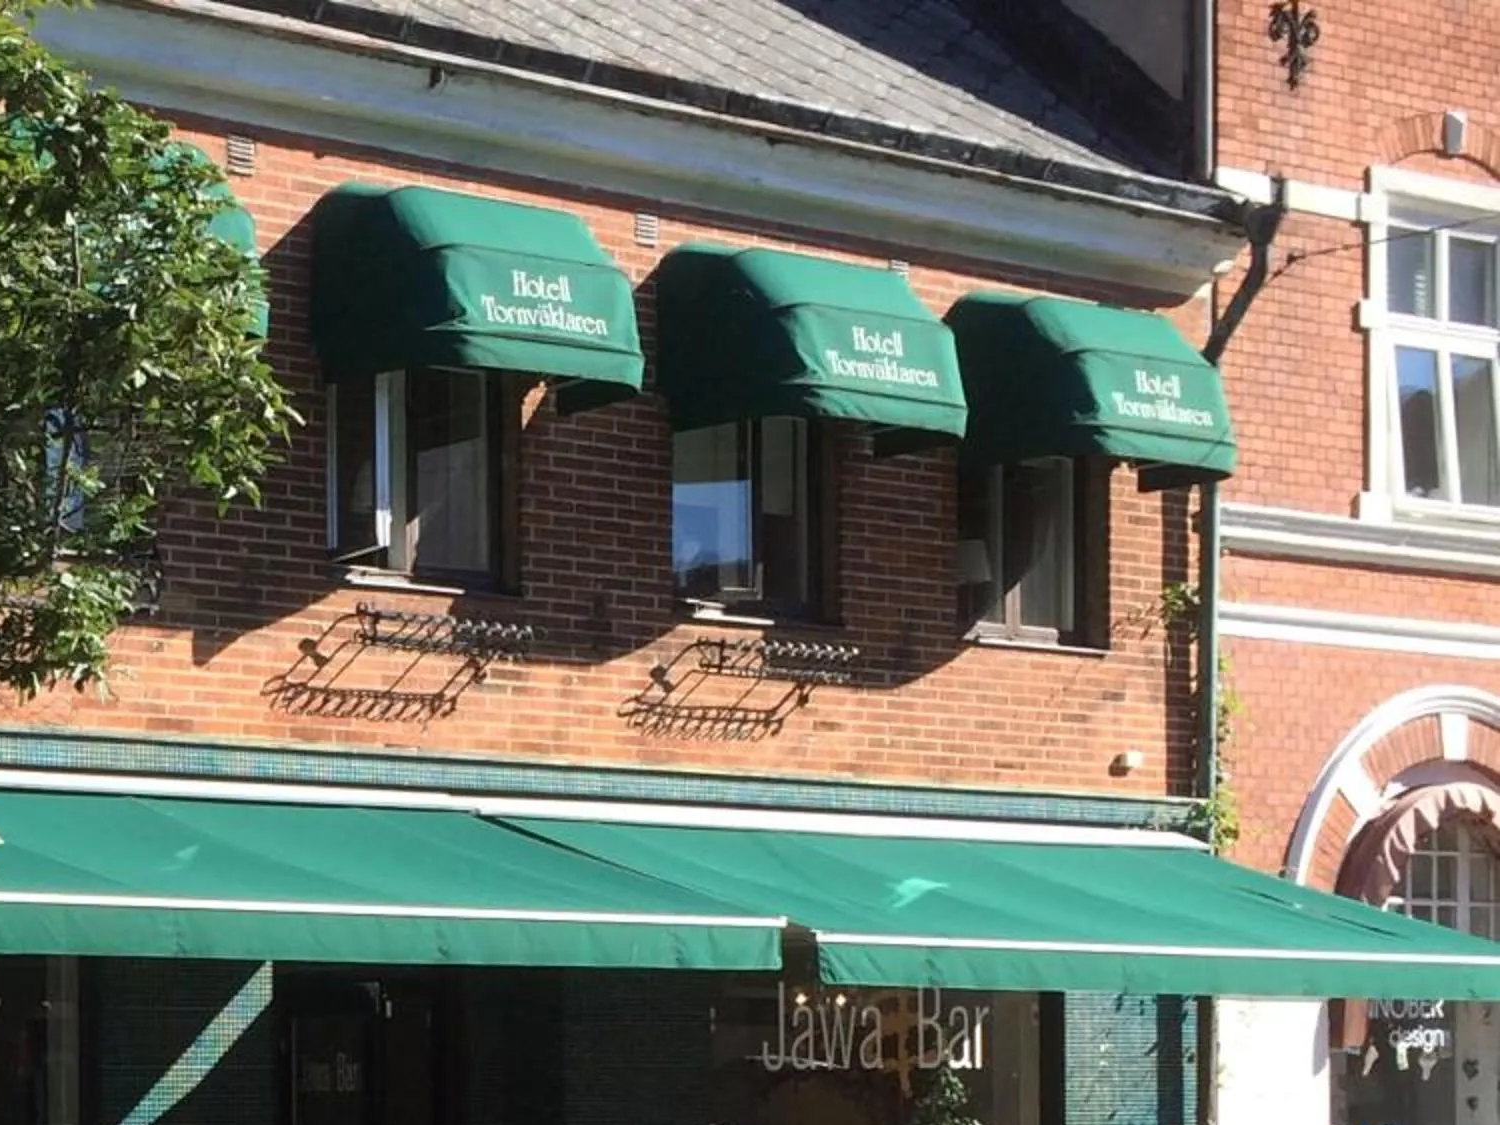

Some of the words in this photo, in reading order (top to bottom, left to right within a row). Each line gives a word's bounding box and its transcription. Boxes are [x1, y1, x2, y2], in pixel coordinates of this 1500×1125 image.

[512, 269, 572, 302] Hotell
[480, 294, 608, 336] Tornväktaren
[852, 326, 904, 357] Hotell
[763, 981, 884, 1072] Jawa
[917, 984, 990, 1070] Bar
